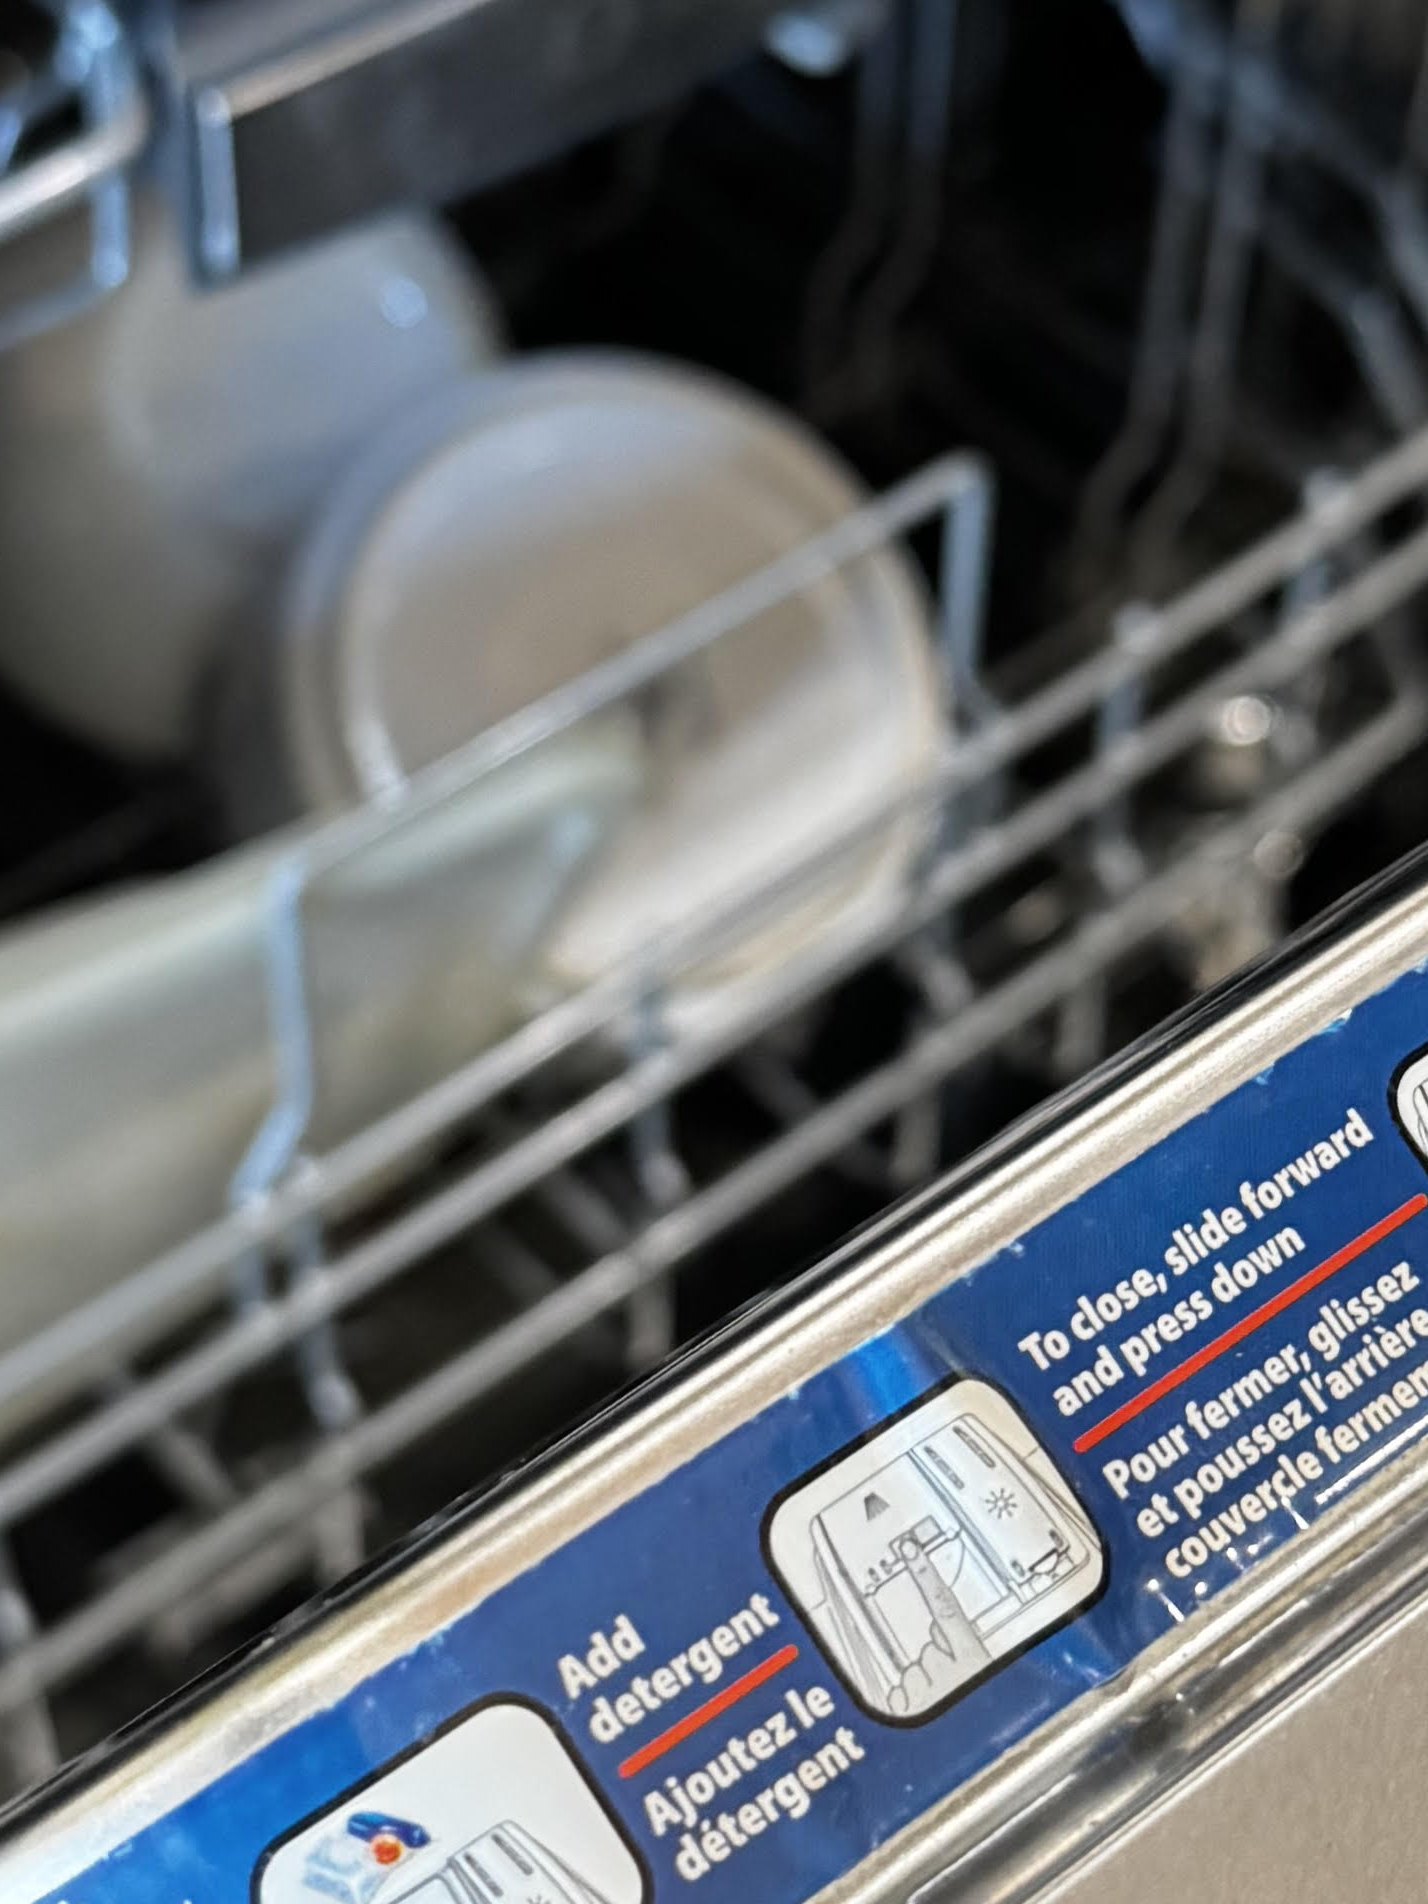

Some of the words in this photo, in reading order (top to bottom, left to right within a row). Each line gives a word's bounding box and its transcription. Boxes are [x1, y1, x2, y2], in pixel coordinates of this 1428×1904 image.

[1018, 1331, 1070, 1372] To
[1070, 1268, 1168, 1341] close,
[1163, 1209, 1246, 1276] slide
[1240, 1107, 1374, 1220] forward
[1052, 1347, 1123, 1416] and
[1120, 1292, 1213, 1376] press
[1210, 1226, 1306, 1303] down
[1102, 1429, 1188, 1500] Pour
[1185, 1344, 1312, 1439] fermer,
[1308, 1261, 1420, 1362] glissez
[1136, 1494, 1179, 1539] et
[1174, 1408, 1312, 1519] poussez
[1164, 1446, 1325, 1579] couvercle
[557, 1614, 646, 1699] Add
[589, 1593, 779, 1743] detergent
[643, 1712, 798, 1837] Ajoutez
[784, 1686, 835, 1729] le
[675, 1726, 865, 1881] détergent
